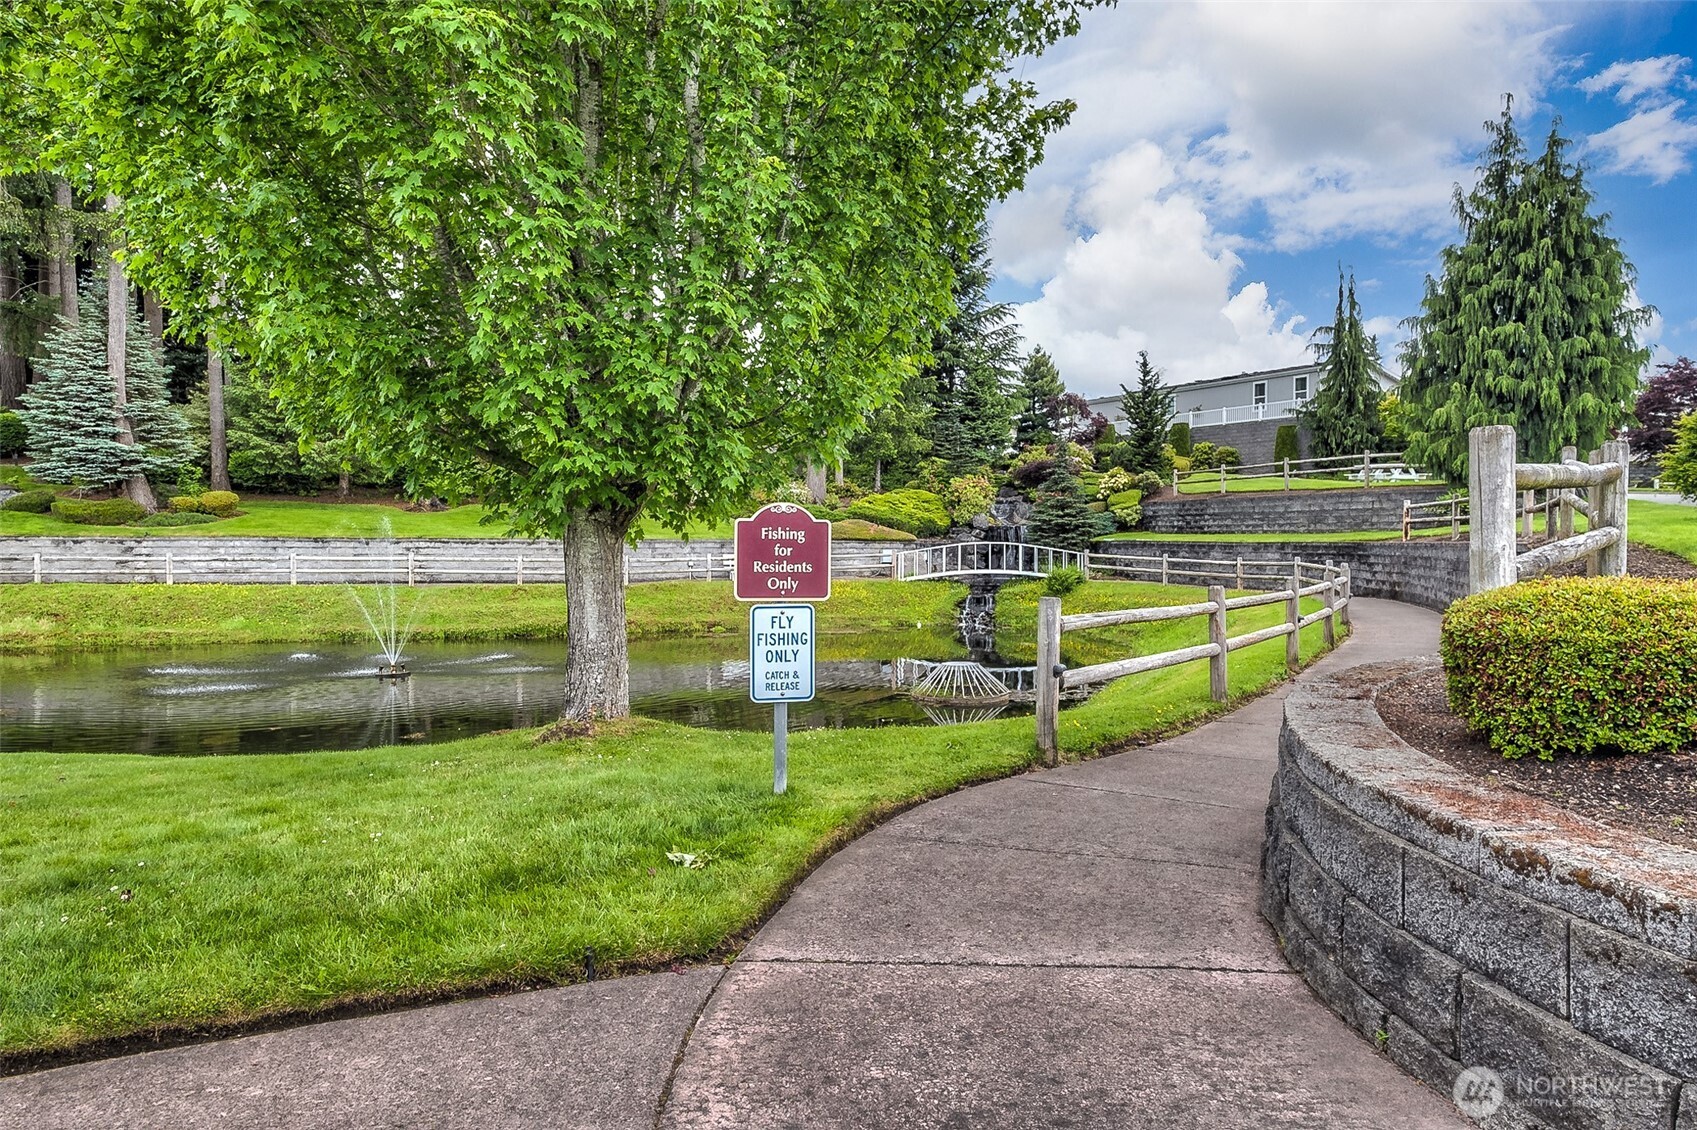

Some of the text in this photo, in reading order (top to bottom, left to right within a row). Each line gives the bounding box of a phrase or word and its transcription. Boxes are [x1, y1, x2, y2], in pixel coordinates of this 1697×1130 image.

[761, 527, 806, 543] Fishing
[774, 543, 793, 556] for
[753, 560, 813, 573] Residents
[767, 577, 799, 593] Only
[771, 616, 794, 629] FLY
[757, 632, 808, 646] FISHING
[765, 650, 799, 663] ONLY
[765, 670, 800, 680] CATCH &
[765, 682, 800, 691] RELEASE
